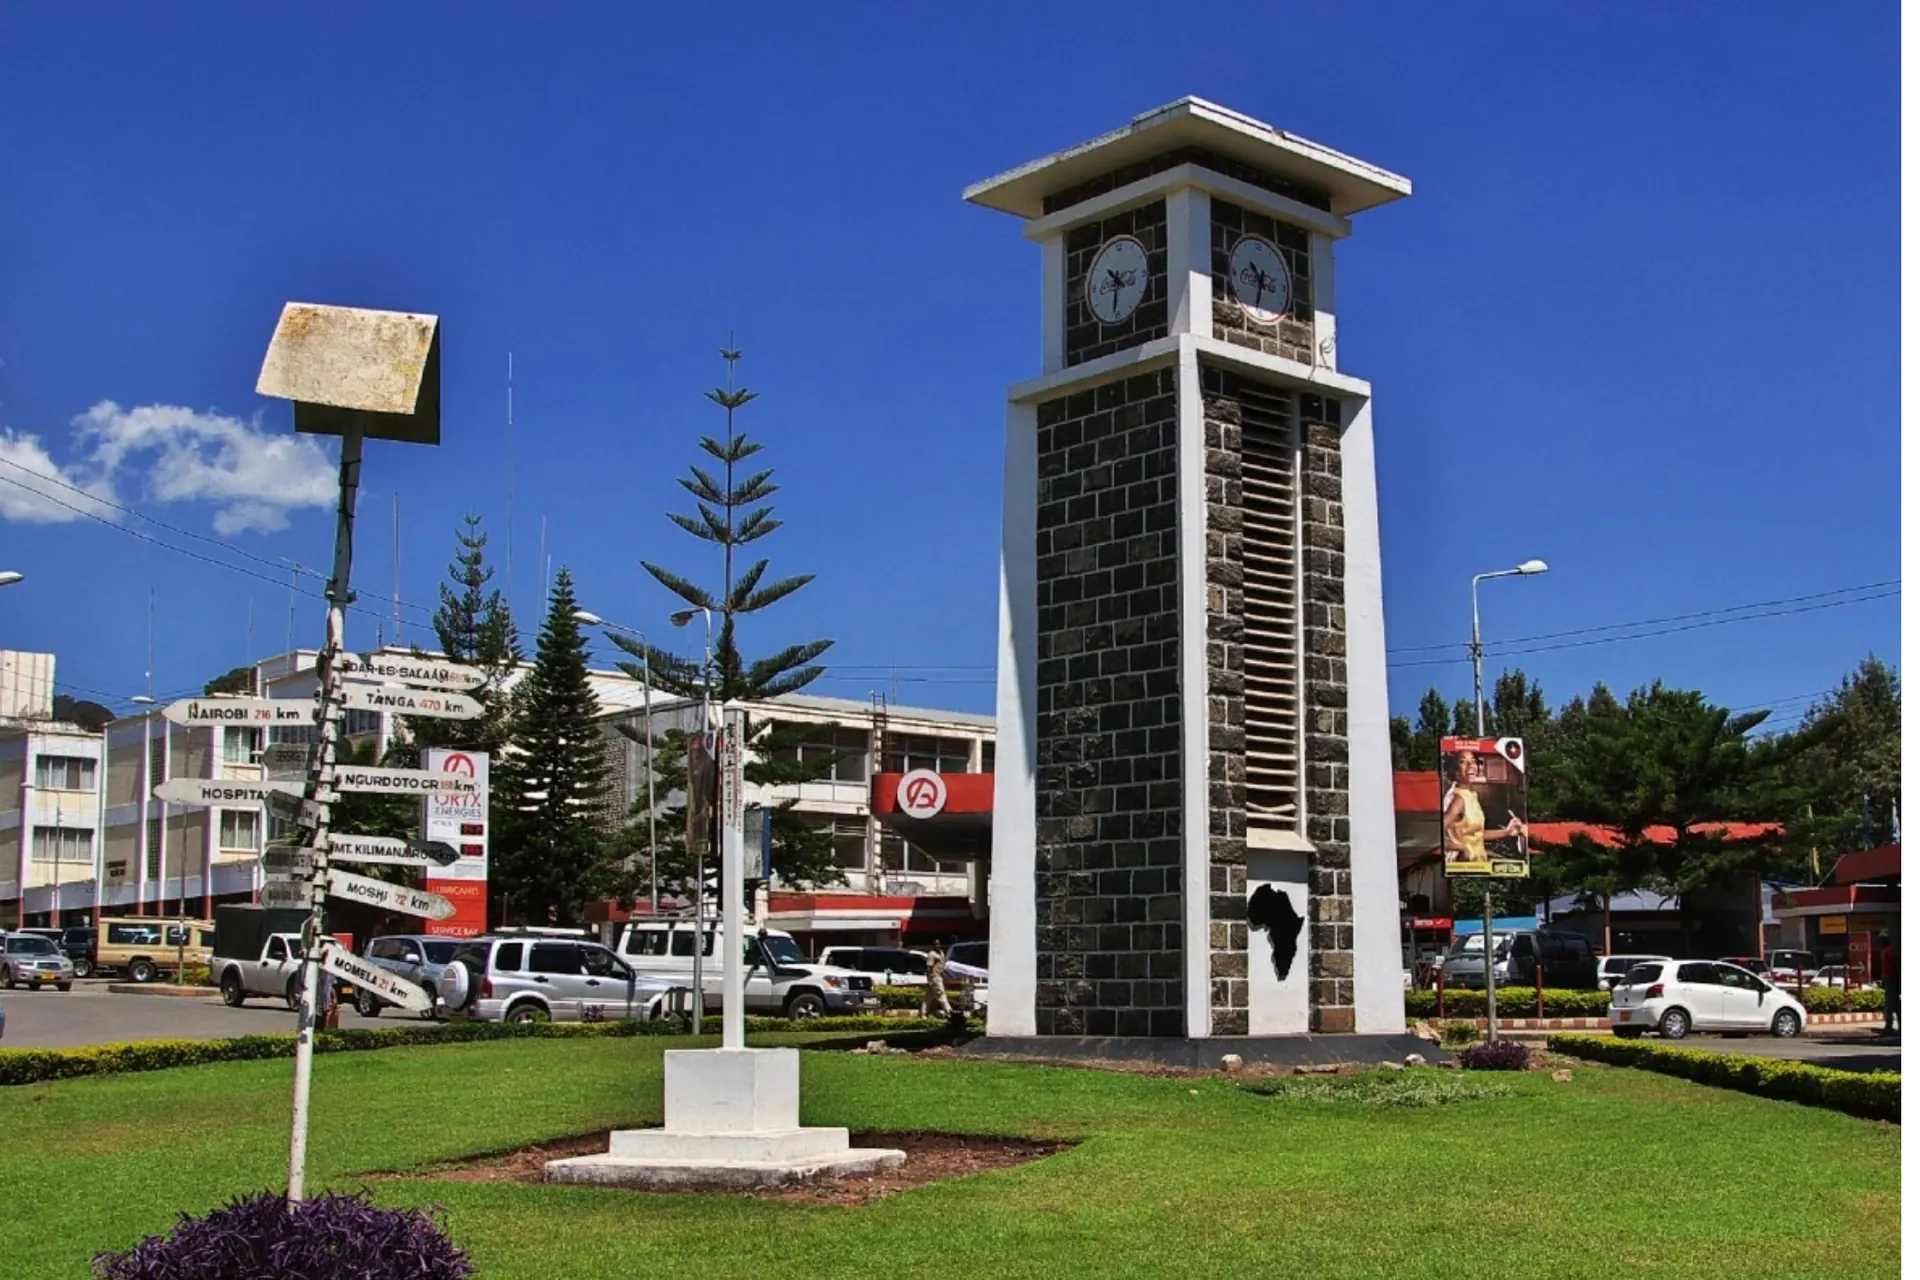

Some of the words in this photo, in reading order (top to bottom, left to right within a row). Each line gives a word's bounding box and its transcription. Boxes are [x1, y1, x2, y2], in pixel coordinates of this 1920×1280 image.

[188, 704, 248, 720] NAIROBI
[276, 707, 300, 719] km
[366, 693, 415, 708] TANGA
[444, 700, 464, 713] km
[345, 774, 419, 788] NGURDOTO
[455, 780, 475, 792] km
[201, 788, 269, 800] HOSPITA
[434, 807, 482, 818] ENERGIES
[346, 882, 389, 901] MOSHI
[410, 896, 430, 911] km
[334, 957, 377, 985] MOMELA
[390, 982, 408, 998] km
